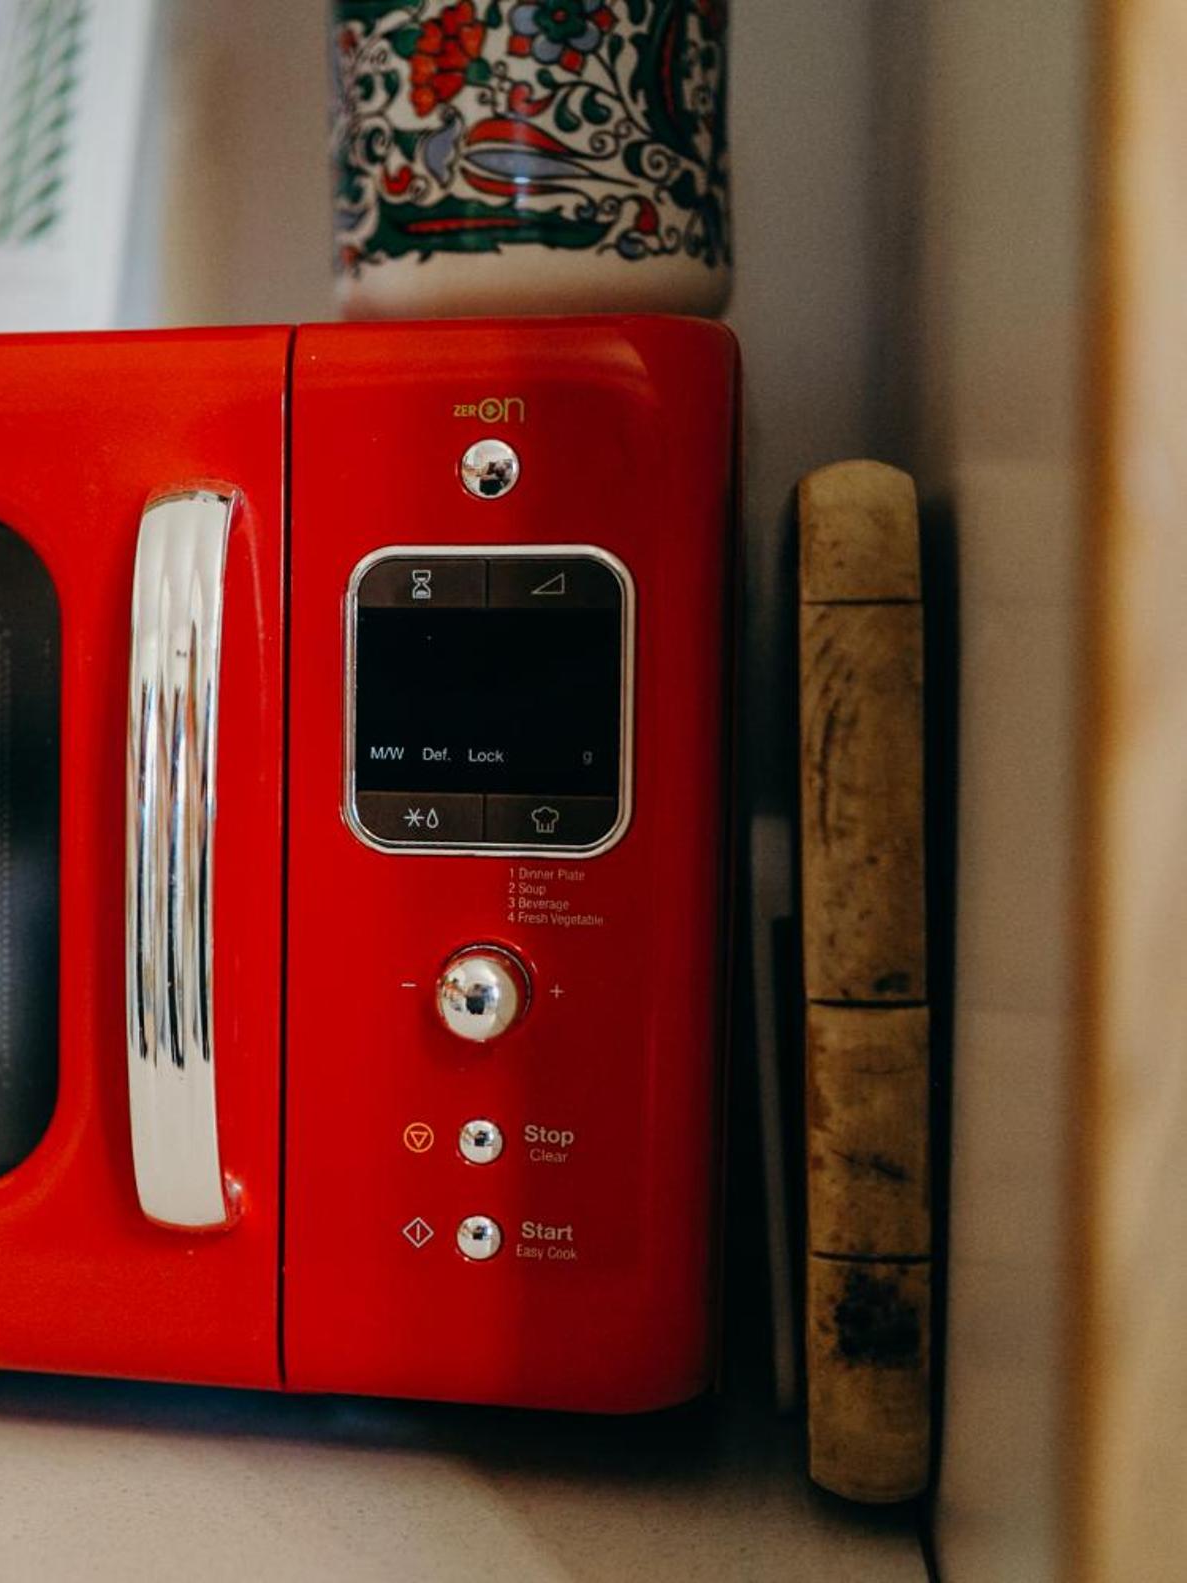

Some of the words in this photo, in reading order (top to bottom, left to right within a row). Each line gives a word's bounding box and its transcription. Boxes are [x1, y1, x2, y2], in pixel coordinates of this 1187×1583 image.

[370, 746, 405, 761] M/W
[422, 747, 452, 762] Def.
[468, 748, 505, 764] Lock
[518, 867, 554, 880] Dinner
[557, 868, 586, 881] Plate
[509, 882, 516, 894] 2
[518, 882, 547, 896] Soup
[509, 897, 516, 909] 3
[518, 897, 570, 912] Beverage
[508, 912, 515, 923] 4
[517, 912, 548, 924] Fresh
[550, 914, 605, 928] Vegetable
[524, 1124, 575, 1147] Stop
[529, 1148, 569, 1163] Clear
[521, 1221, 574, 1241] Start
[516, 1244, 544, 1261] Easy
[547, 1246, 578, 1261] Cook
